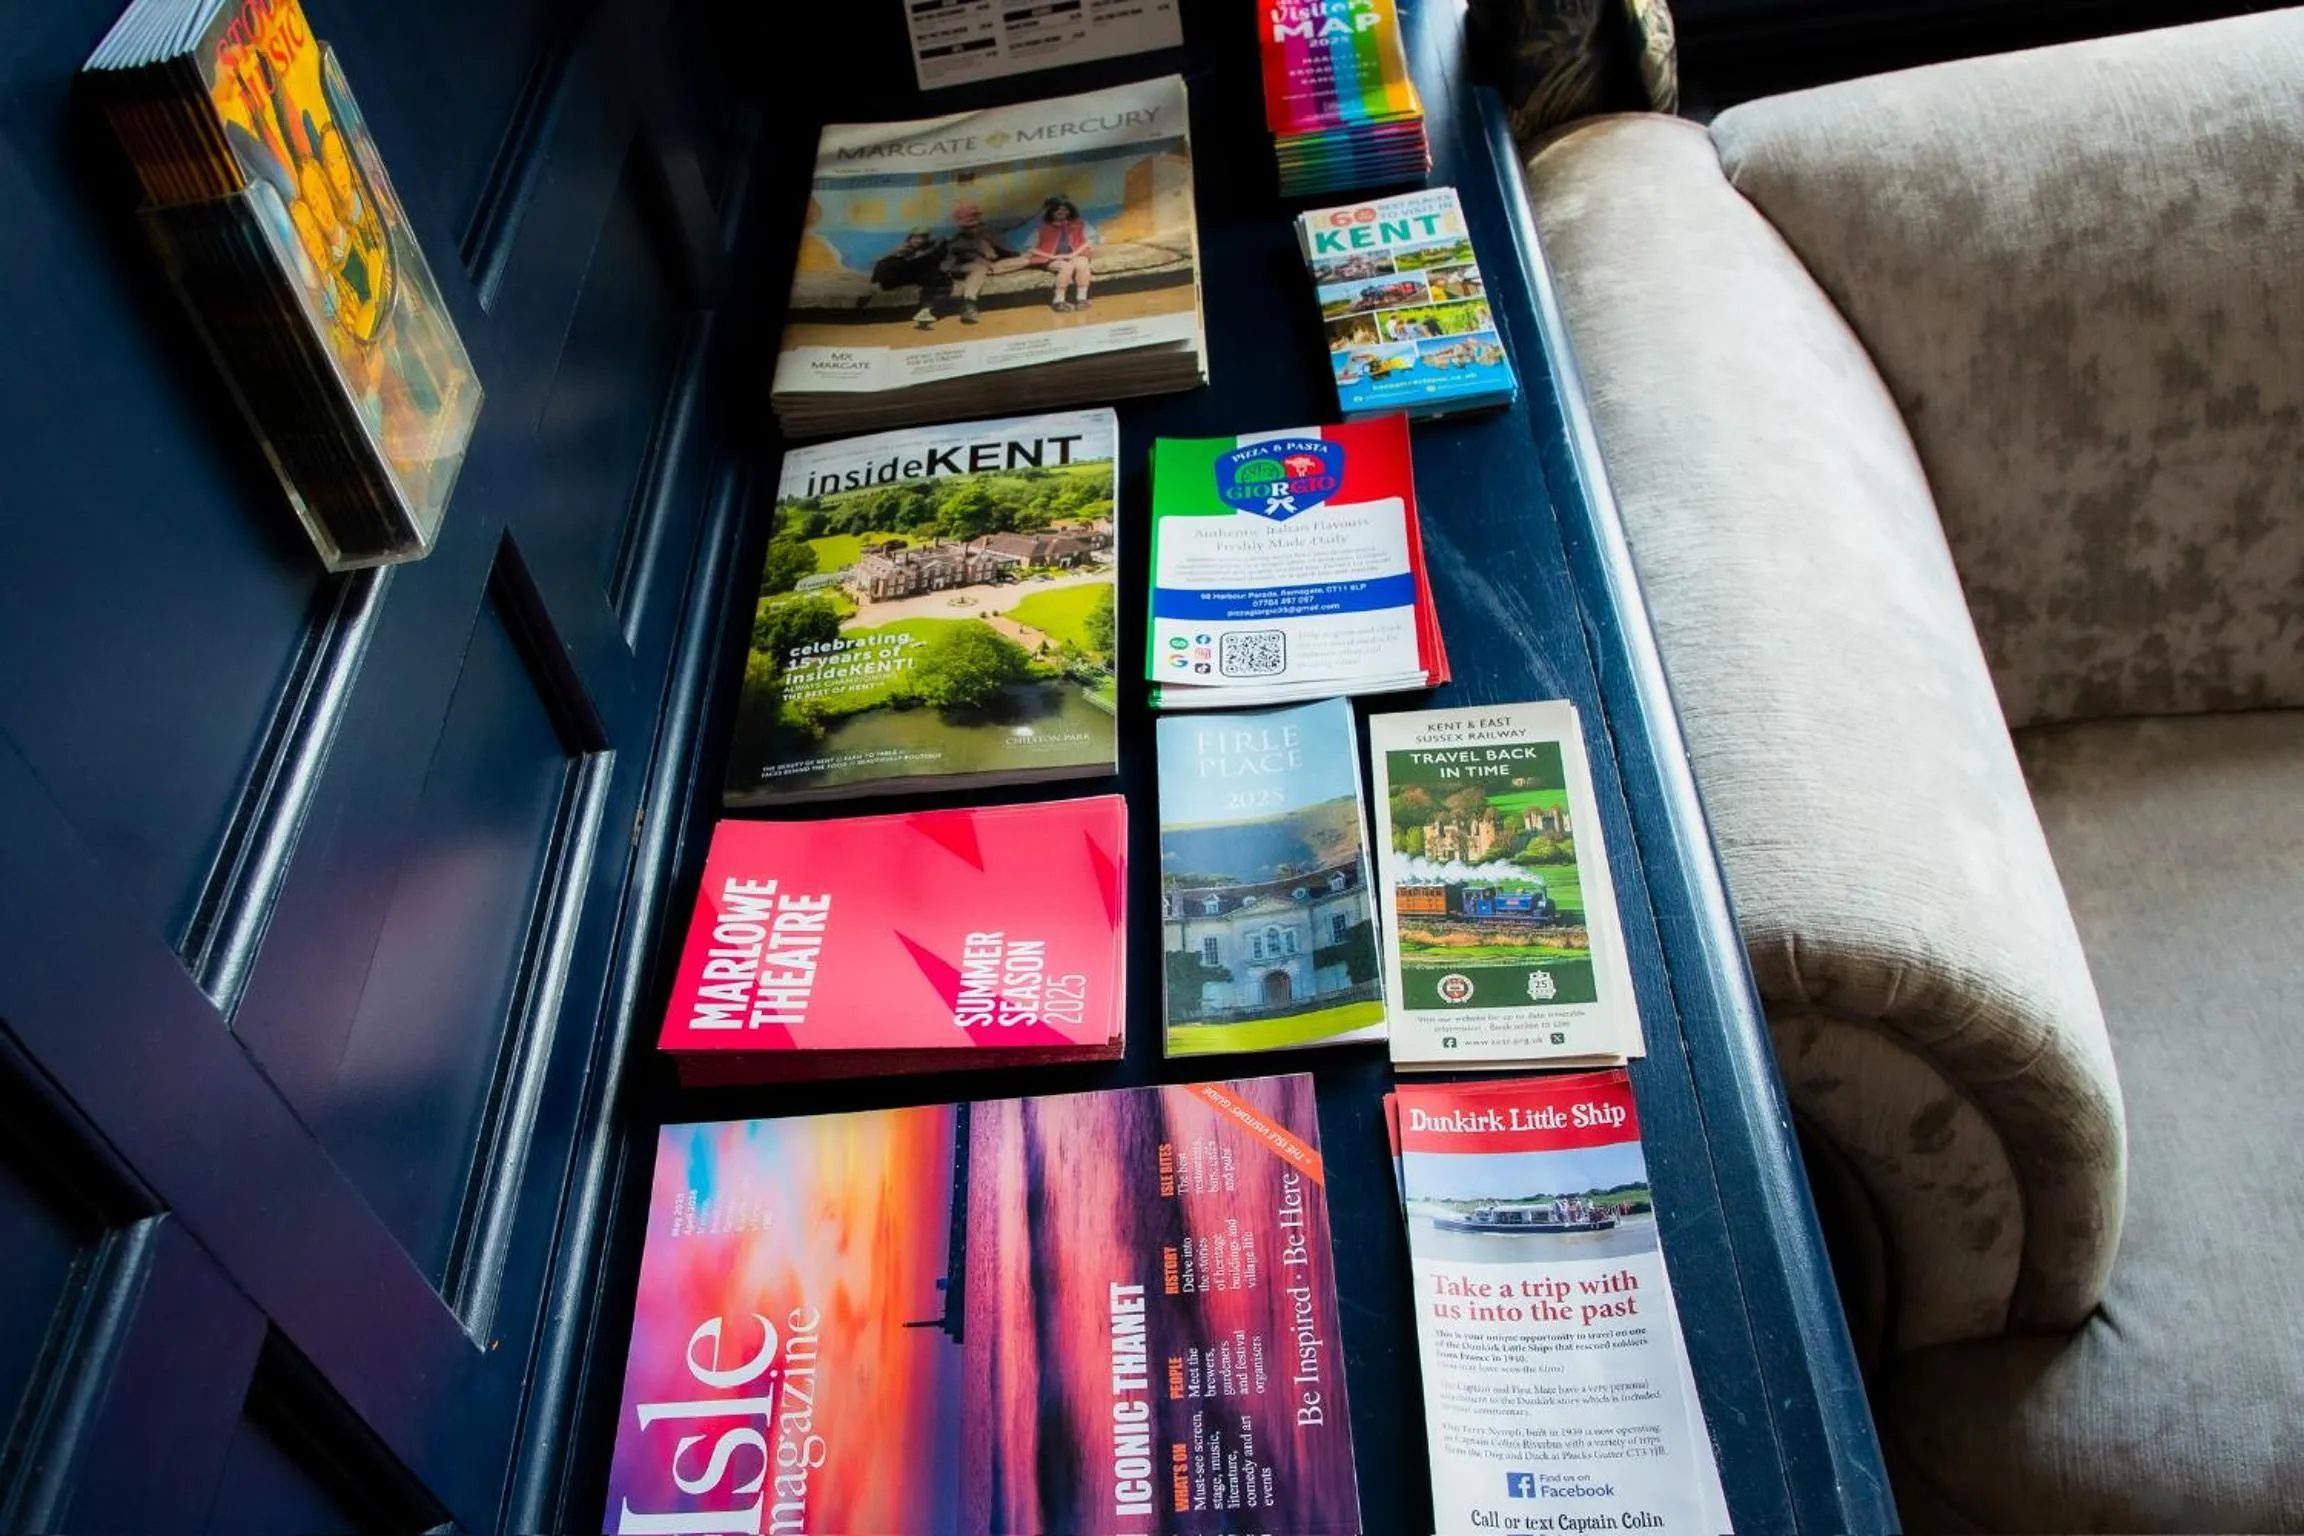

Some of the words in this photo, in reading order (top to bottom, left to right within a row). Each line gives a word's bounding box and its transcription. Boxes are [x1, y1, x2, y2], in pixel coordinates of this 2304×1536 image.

[1273, 12, 1382, 43] MAP
[1309, 36, 1350, 48] 2025
[235, 5, 305, 114] MUSIC
[836, 135, 979, 162] MARGATE
[1015, 105, 1163, 143] MERCURY
[1329, 206, 1377, 228] 60
[1314, 213, 1441, 254] KENT
[811, 360, 871, 370] MARGATE
[807, 433, 1083, 498] insideKENT
[1232, 446, 1269, 463] PIZZA
[1286, 442, 1328, 454] PASTA
[1225, 475, 1336, 500] GIORGIO
[785, 657, 914, 686] insideKENT!
[786, 657, 813, 671] 15
[816, 650, 872, 669] years
[879, 644, 902, 658] of
[783, 691, 801, 702] THE
[1063, 733, 1091, 743] PARK
[1197, 724, 1300, 755] FIRLE
[1415, 732, 1464, 744] SUSSEX
[1467, 728, 1528, 740] RAILWAY
[1427, 721, 1464, 732] KENT
[1467, 720, 1476, 729] &
[1480, 716, 1513, 729] EAST
[1200, 748, 1303, 778] PLACE
[1410, 750, 1481, 765] TRAVEL
[1486, 747, 1538, 762] BACK
[1440, 767, 1460, 779] IN
[1465, 764, 1511, 778] TIME
[1225, 788, 1286, 810] 2025
[688, 876, 779, 1031] MARLOWE
[749, 892, 832, 1030] THEATRE
[953, 930, 1004, 1028] SUMMER
[997, 939, 1046, 1028] SEASON
[1042, 973, 1088, 1025] 2025
[1409, 1108, 1505, 1133] Dunkirk
[1509, 1106, 1568, 1132] Little
[1571, 1102, 1627, 1129] Ship
[1158, 1143, 1174, 1167] BITES
[1160, 1168, 1175, 1198] ISLE
[1177, 1178, 1189, 1196] The
[1222, 1173, 1235, 1192] and
[1278, 1171, 1305, 1229] Here
[1226, 1218, 1238, 1237] and
[1242, 1230, 1253, 1248] life
[1182, 1236, 1193, 1257] into
[1197, 1236, 1209, 1272] stories
[1211, 1233, 1226, 1277] heritage
[1283, 1236, 1309, 1266] Be
[1164, 1246, 1180, 1295] HISTORY
[1182, 1258, 1195, 1294] Delve
[1228, 1240, 1242, 1290] buildings
[1244, 1250, 1259, 1288] village
[1197, 1274, 1210, 1293] the
[1213, 1278, 1225, 1292] of
[1430, 1273, 1493, 1298] Take
[1499, 1282, 1515, 1298] a
[1521, 1276, 1571, 1302] trip
[1578, 1269, 1640, 1295] with
[1432, 1301, 1462, 1320] us
[1470, 1300, 1524, 1322] into
[1531, 1300, 1574, 1321] the
[1581, 1295, 1639, 1326] past
[1109, 1281, 1149, 1397] THANET
[1286, 1285, 1324, 1384] Inspired
[1186, 1347, 1199, 1367] the
[1232, 1329, 1246, 1375] festival
[1249, 1335, 1268, 1394] organisers
[1168, 1355, 1185, 1400] PEOPLE
[1204, 1347, 1217, 1397] brewers,
[1218, 1340, 1236, 1397] gardeners
[1187, 1370, 1201, 1399] Meet
[1236, 1377, 1249, 1396] and
[616, 1311, 779, 1535] Isle
[767, 1305, 827, 1536] magazine
[1239, 1414, 1251, 1431] art
[1297, 1390, 1324, 1426] Be
[1192, 1410, 1204, 1451] screen,
[1241, 1432, 1254, 1457] and
[1112, 1400, 1153, 1517] ICONIC
[1172, 1443, 1187, 1460] ON
[1208, 1430, 1222, 1471] music,
[1173, 1462, 1190, 1513] WHAT'S
[1193, 1454, 1207, 1511] Must-see
[1211, 1475, 1226, 1510] stage,
[1226, 1450, 1240, 1509] literature,
[1242, 1458, 1258, 1507] comedy
[1261, 1466, 1274, 1507] events
[1538, 1474, 1562, 1484] Find
[1563, 1475, 1576, 1483] us
[1577, 1474, 1591, 1482] on
[1540, 1484, 1616, 1498] Facebook
[1470, 1509, 1500, 1529] Call
[1504, 1516, 1522, 1529] or
[1524, 1514, 1554, 1531] text
[1557, 1513, 1618, 1534] Captain
[1621, 1511, 1665, 1529] Colin
